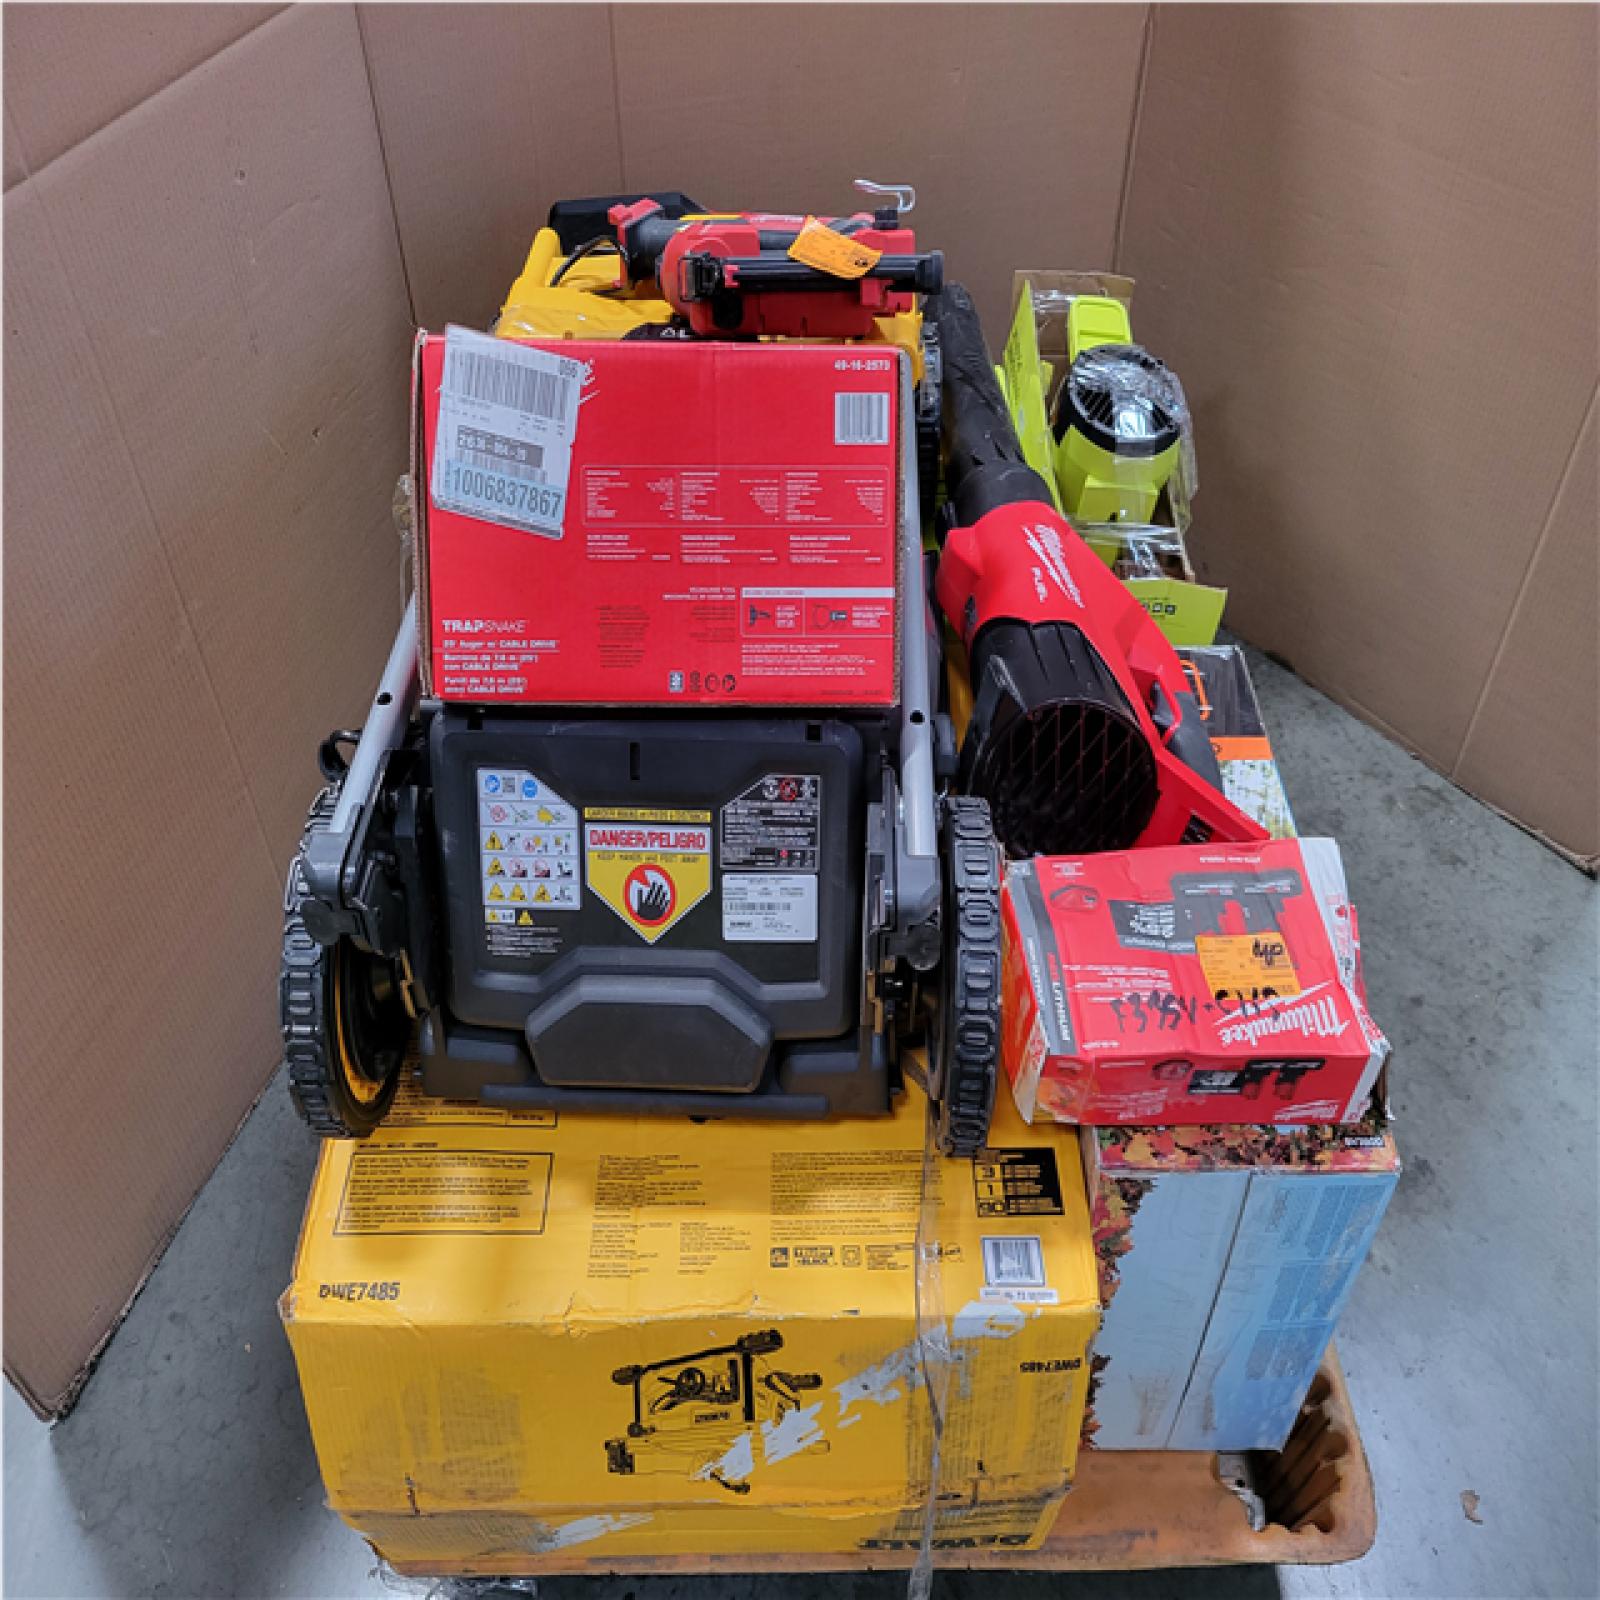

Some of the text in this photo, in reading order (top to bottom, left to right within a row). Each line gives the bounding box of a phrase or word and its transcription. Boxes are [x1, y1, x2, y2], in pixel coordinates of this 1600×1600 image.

[453, 467, 563, 518] 1006837867
[442, 619, 527, 633] TRAPSNAKE
[589, 829, 706, 850] DANGER/PELIGRO
[1221, 994, 1350, 1048] Milwaukee
[318, 1281, 401, 1302] DWE7485
[1020, 1356, 1081, 1374] DWE7485
